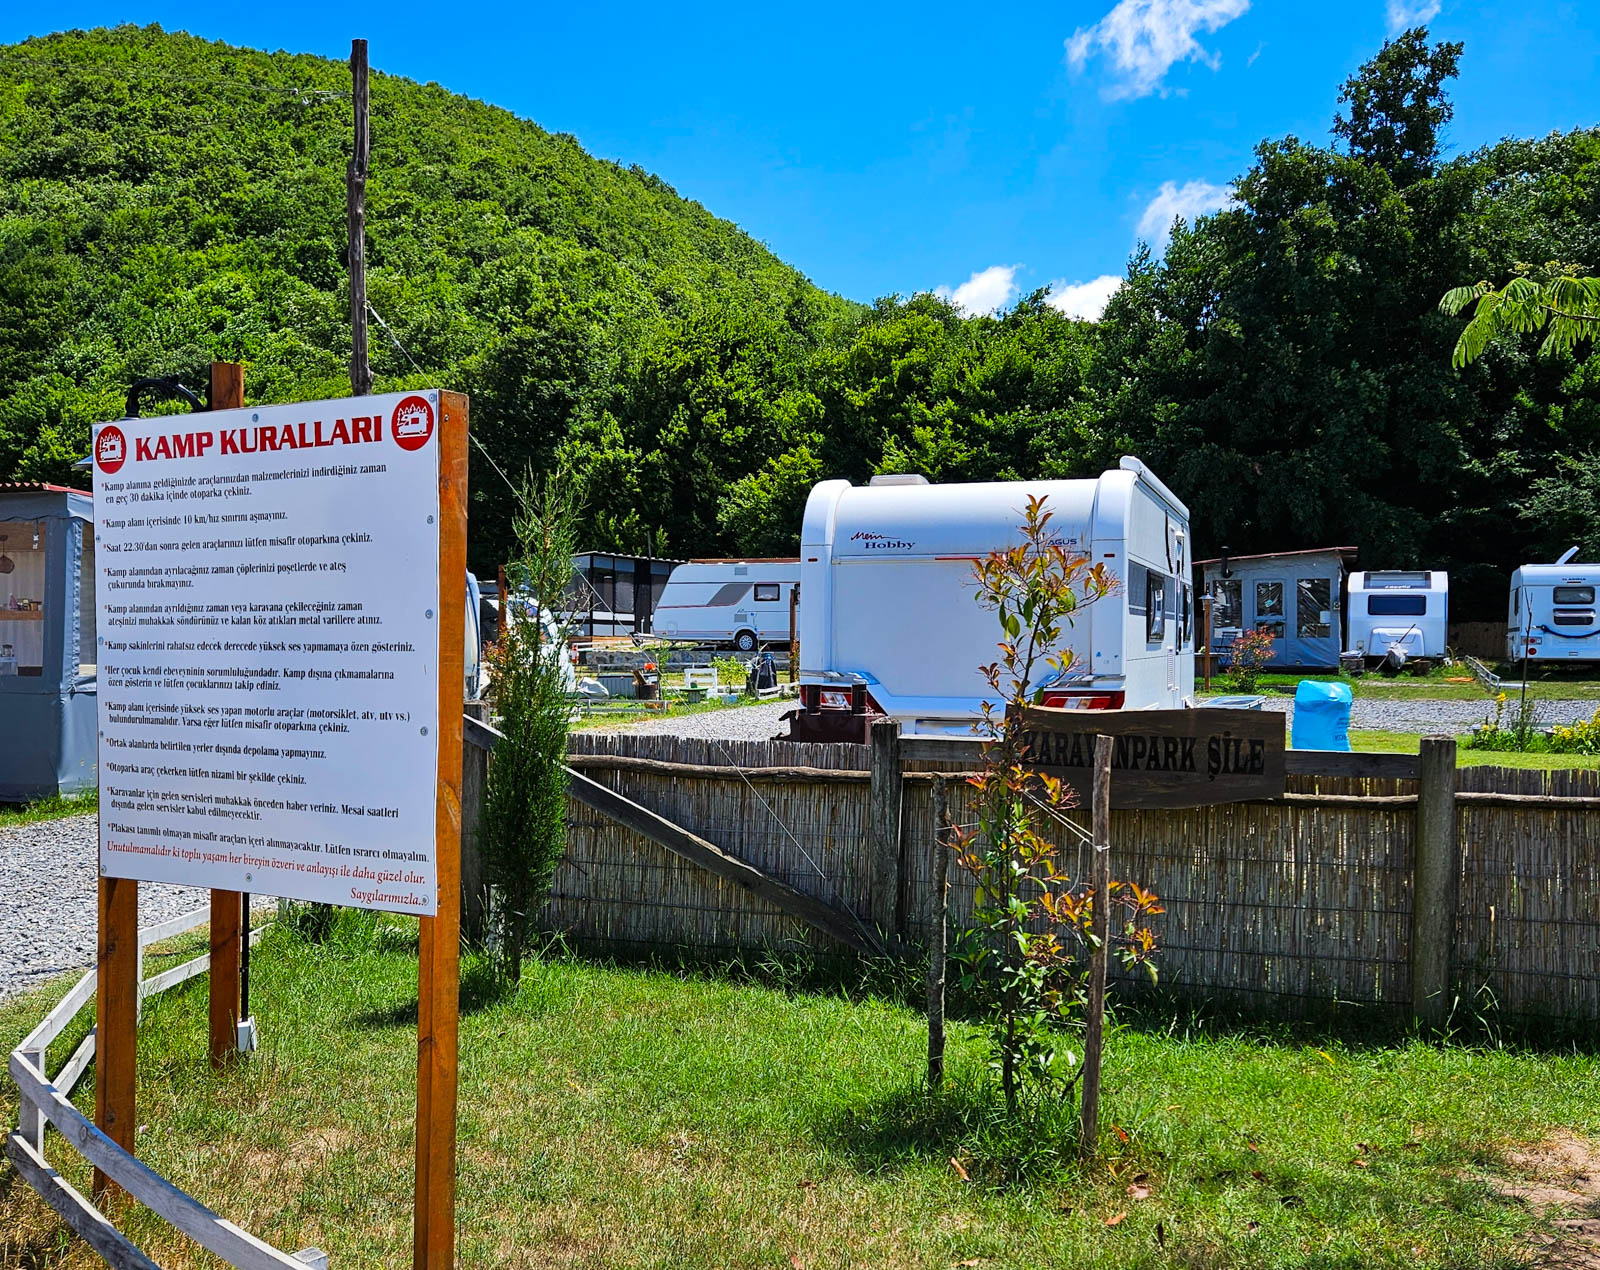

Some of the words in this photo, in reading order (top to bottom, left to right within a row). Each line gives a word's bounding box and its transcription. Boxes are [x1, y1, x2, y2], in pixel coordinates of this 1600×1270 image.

[135, 431, 214, 462] KAMP
[219, 415, 382, 456] KURALLARI
[126, 480, 152, 490] alanına
[359, 464, 387, 474] zaman
[105, 496, 114, 504] en
[115, 495, 128, 505] geç
[130, 492, 139, 502] 30
[140, 491, 165, 502] dakika
[166, 489, 188, 503] içinde
[190, 487, 222, 500] otoparka
[127, 517, 145, 527] alanı
[184, 514, 192, 524] 10
[194, 513, 219, 524] km/hız
[221, 514, 248, 523] sınırını
[159, 542, 179, 551] sonra
[181, 540, 201, 552] gelen
[245, 537, 267, 547] lütfen
[269, 535, 296, 546] misafir
[850, 531, 897, 541] Mein
[865, 540, 916, 550] Hobby
[128, 566, 163, 576] alanından
[211, 566, 234, 574] zaman
[319, 563, 328, 571] ve
[329, 561, 347, 573] ateş
[108, 579, 145, 592] çukurunda
[129, 603, 163, 613] alanından
[206, 604, 229, 612] zaman
[231, 604, 247, 614] veya
[249, 602, 283, 612] karavana
[337, 603, 363, 611] zaman
[108, 614, 137, 628] ateşinizi
[138, 616, 175, 626] muhakkak
[221, 617, 229, 625] ve
[231, 615, 251, 625] kalan
[253, 615, 267, 625] köz
[268, 615, 297, 625] atıkları
[299, 615, 321, 625] metal
[322, 614, 356, 625] varillere
[167, 640, 195, 650] rahatsız
[196, 640, 222, 651] edecek
[224, 641, 257, 651] derecede
[259, 641, 286, 653] yüksek
[288, 643, 301, 652] ses
[303, 643, 349, 654] yapmamaya
[350, 641, 369, 652] özen
[121, 665, 141, 678] çocuk
[143, 666, 162, 675] kendi
[283, 667, 306, 680] Kamp
[307, 668, 332, 680] dışına
[108, 677, 123, 687] özen
[124, 677, 152, 688] gösterin
[154, 680, 162, 688] ve
[163, 678, 184, 688] lütfen
[234, 680, 254, 692] takip
[128, 702, 144, 711] alanı
[180, 703, 205, 716] yüksek
[207, 706, 219, 715] ses
[221, 707, 242, 717] yapan
[244, 706, 275, 717] motorlu
[276, 707, 305, 719] araçlar
[361, 710, 377, 721] atv,
[379, 711, 393, 721] utv
[395, 711, 410, 722] vs.)
[182, 716, 202, 727] Varsa
[203, 717, 220, 729] eğer
[221, 718, 243, 728] lütfen
[245, 719, 272, 730] misafir
[128, 739, 159, 750] alanlarda
[193, 743, 214, 754] yerler
[215, 743, 241, 756] dışında
[243, 744, 279, 757] depolama
[1023, 730, 1197, 773] KARAVNPARK
[1207, 730, 1265, 782] ŞİLE
[140, 766, 155, 776] araç
[156, 766, 187, 777] çekerken
[188, 767, 210, 778] lütfen
[211, 769, 235, 780] nizami
[236, 770, 247, 781] bir
[248, 772, 276, 784] şekilde
[111, 799, 135, 811] dışında
[136, 801, 155, 811] gelen
[156, 803, 185, 814] servisler
[187, 805, 206, 816] kabul
[147, 789, 160, 801] için
[161, 791, 180, 801] gelen
[214, 795, 252, 807] muhakkak
[253, 797, 284, 809] önceden
[286, 800, 308, 812] haber
[341, 804, 365, 816] Mesai
[366, 807, 399, 818] saatleri
[137, 826, 161, 836] tanımlı
[162, 827, 191, 840] olmayan
[193, 830, 218, 841] misafir
[219, 834, 247, 846] araçları
[248, 835, 265, 848] içeri
[325, 843, 351, 855] Lütfen
[353, 848, 380, 858] ısrarcı
[172, 846, 180, 858] ki
[181, 848, 201, 862] toplu
[202, 853, 227, 864] yaşam
[229, 851, 242, 864] her
[243, 853, 270, 870] bireyin
[271, 857, 295, 870] özveri
[296, 863, 305, 871] ve
[306, 861, 338, 877] anlayışı
[340, 864, 351, 877] ile
[352, 865, 375, 880] daha
[377, 869, 402, 885] güzel
[404, 870, 425, 884] olur.
